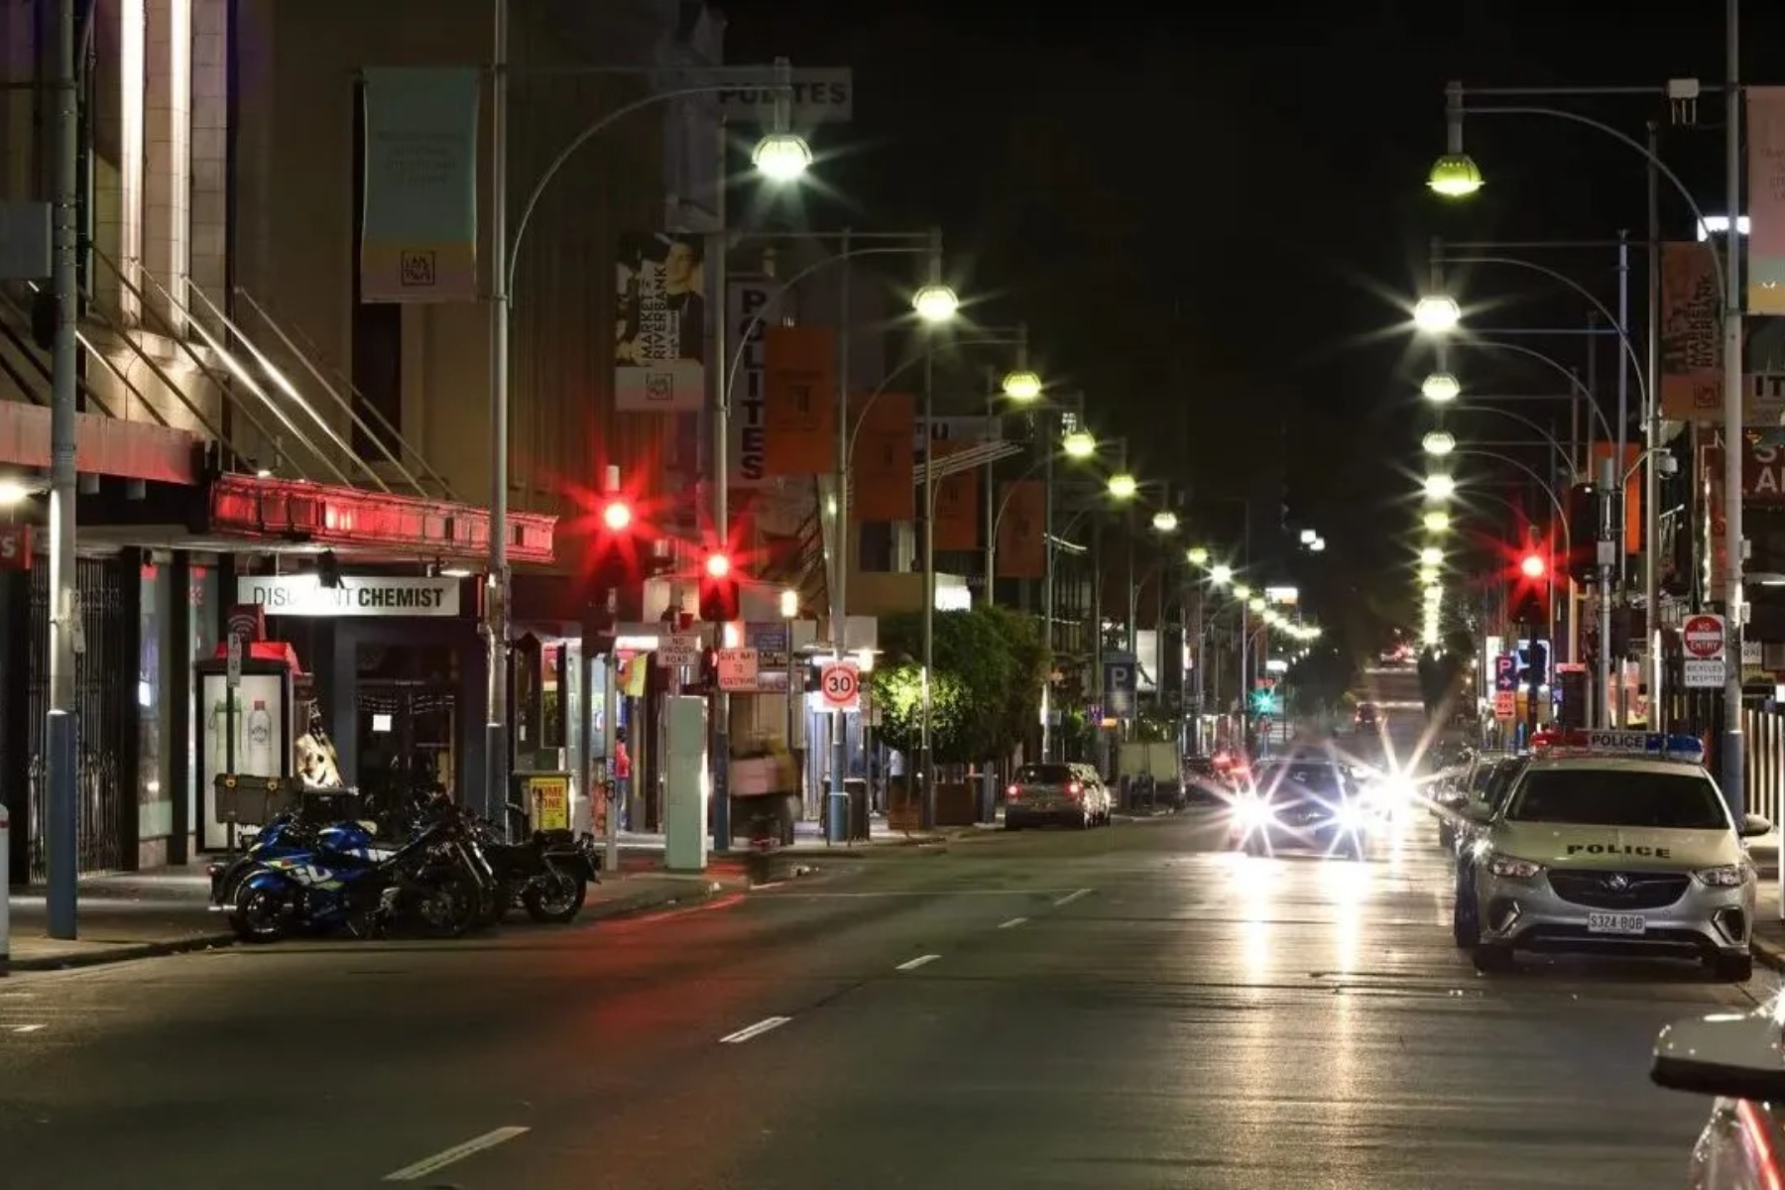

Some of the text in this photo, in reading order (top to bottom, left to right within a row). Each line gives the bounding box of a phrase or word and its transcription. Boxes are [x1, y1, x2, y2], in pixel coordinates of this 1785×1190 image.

[718, 82, 848, 104] POLTES
[654, 266, 667, 359] RIVERBANK
[641, 294, 652, 359] MARKET
[358, 587, 444, 607] CHEMIST
[1697, 621, 1712, 631] NO
[1689, 641, 1719, 651] ENTRY
[665, 655, 688, 663] ROAD
[1500, 659, 1512, 674] P
[829, 676, 851, 692] 30
[1111, 667, 1128, 688] P
[1591, 733, 1644, 748] POLICE
[1567, 844, 1671, 859] POLICE
